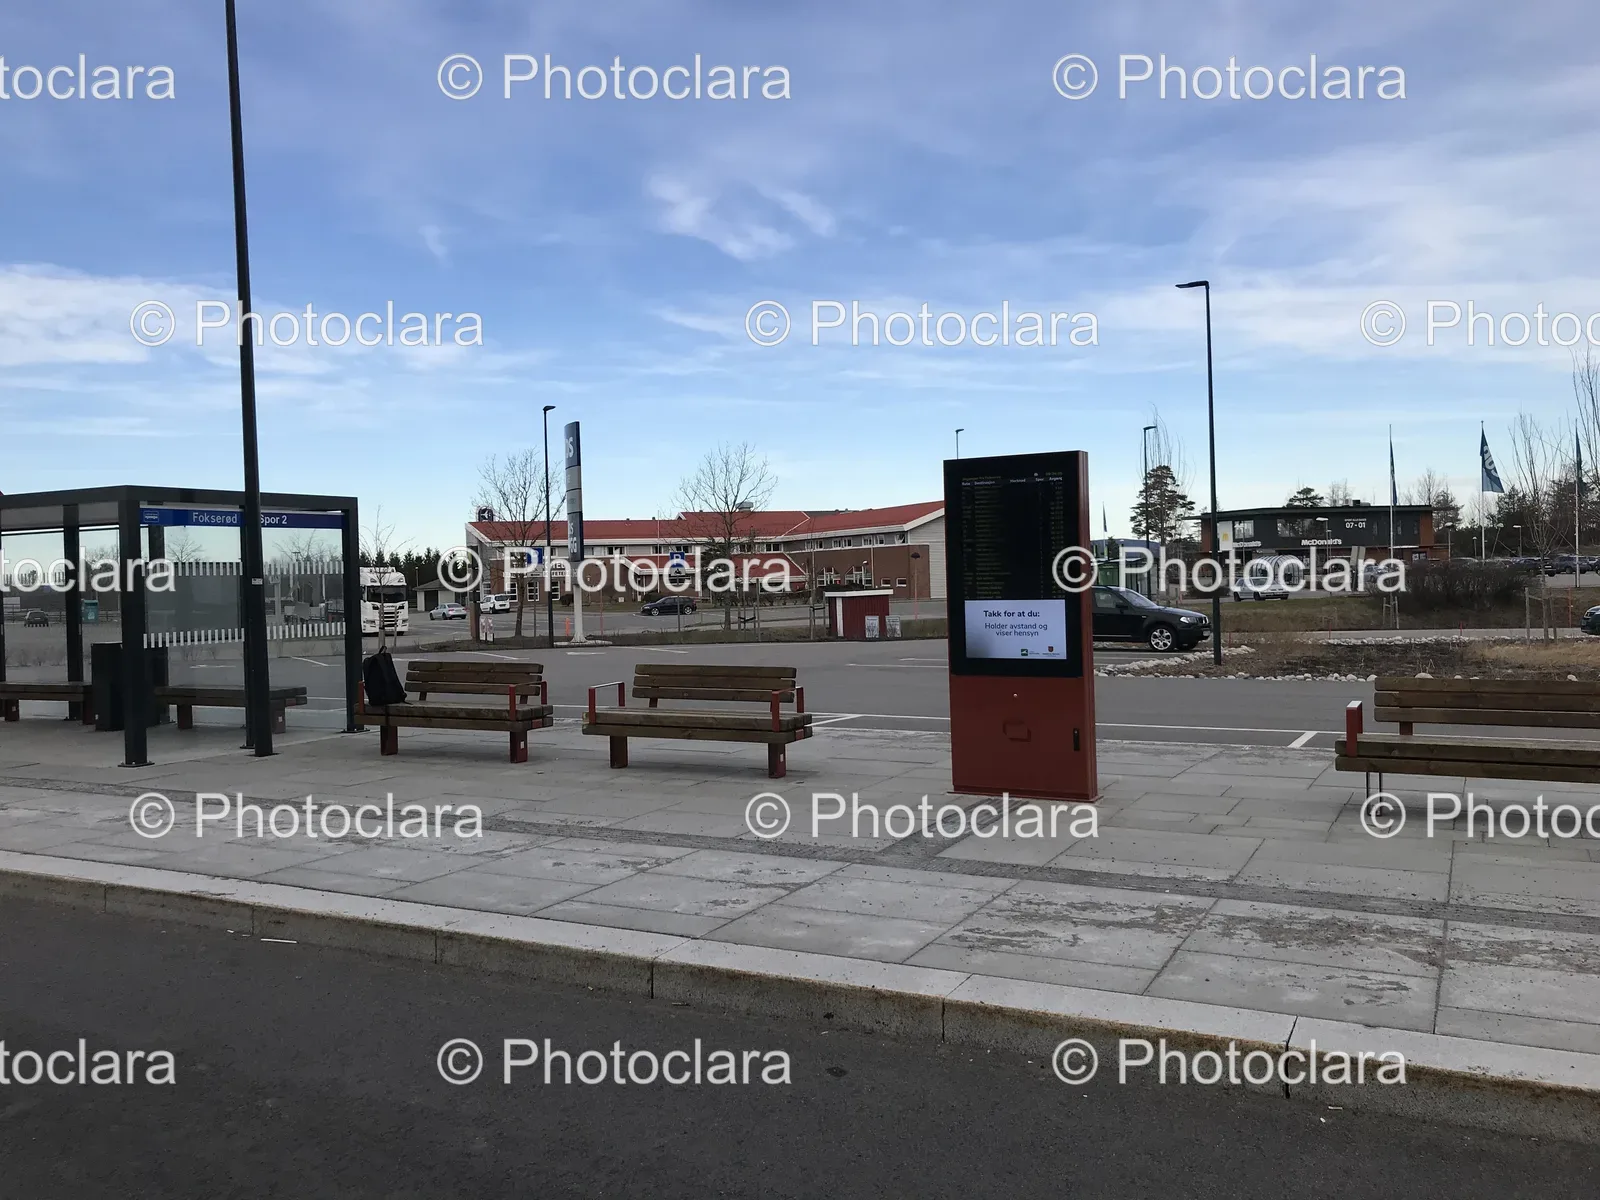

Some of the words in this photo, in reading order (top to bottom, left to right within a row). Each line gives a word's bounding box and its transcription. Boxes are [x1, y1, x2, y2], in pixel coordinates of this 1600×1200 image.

[192, 512, 238, 524] Fokserød
[281, 515, 288, 525] 2
[983, 610, 1002, 618] Takk
[1004, 610, 1015, 618] for
[1017, 610, 1025, 618] at
[1027, 610, 1040, 618] du:
[984, 622, 1008, 630] Holder
[1009, 622, 1037, 630] avstand
[1013, 629, 1039, 637] hensyn
